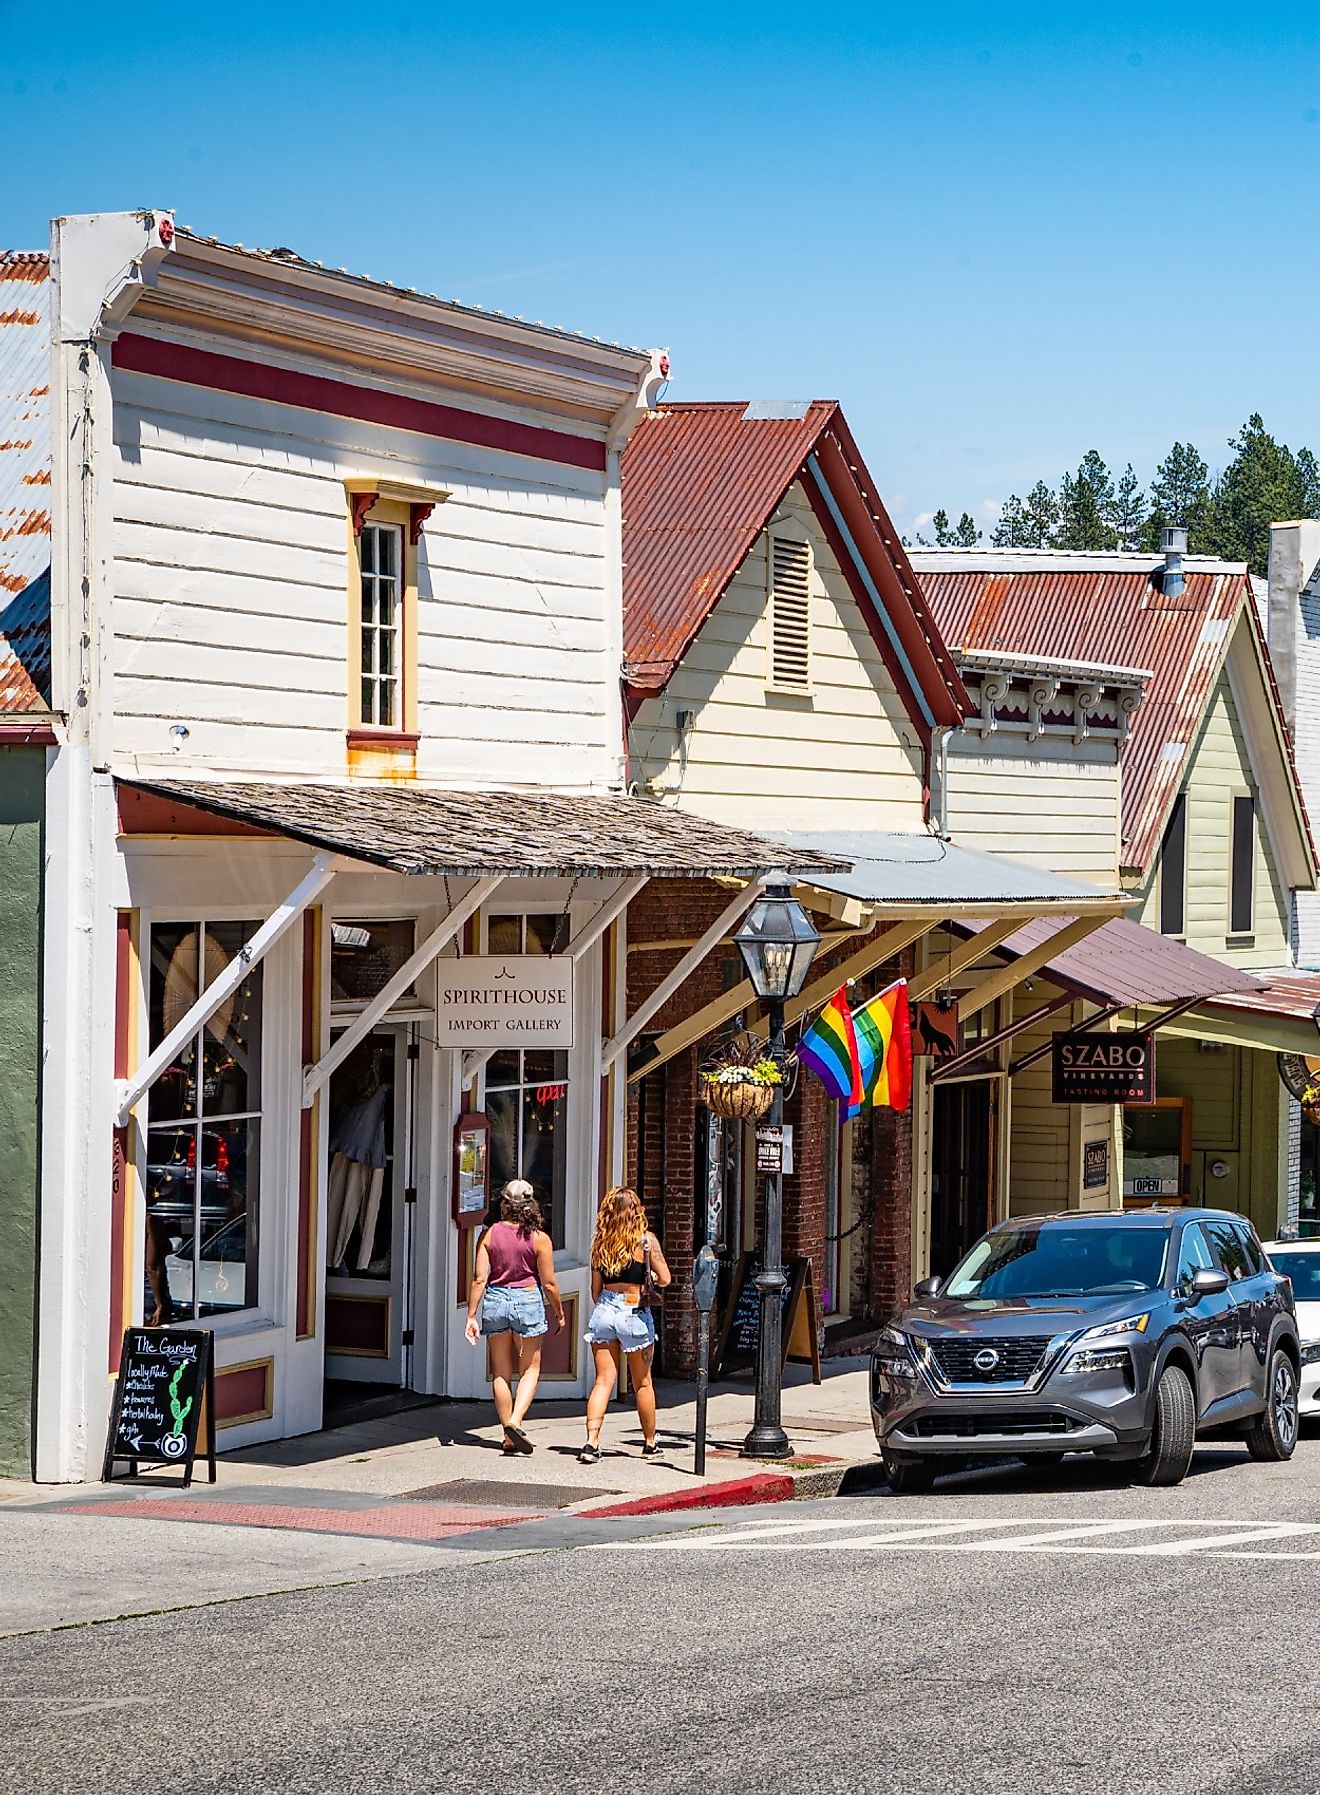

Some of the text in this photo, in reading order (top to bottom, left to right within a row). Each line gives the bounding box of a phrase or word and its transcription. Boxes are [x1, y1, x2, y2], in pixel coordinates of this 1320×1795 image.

[443, 989, 566, 1005] SPIRITHOUSE
[448, 1019, 561, 1031] IMPORT GALLERY
[1061, 1045, 1145, 1067] SZABO
[1063, 1072, 1144, 1080] VINEYARDS
[1064, 1088, 1144, 1097] TASTING ROOM
[1136, 1180, 1160, 1192] OPEN
[134, 1335, 198, 1358] The Garden
